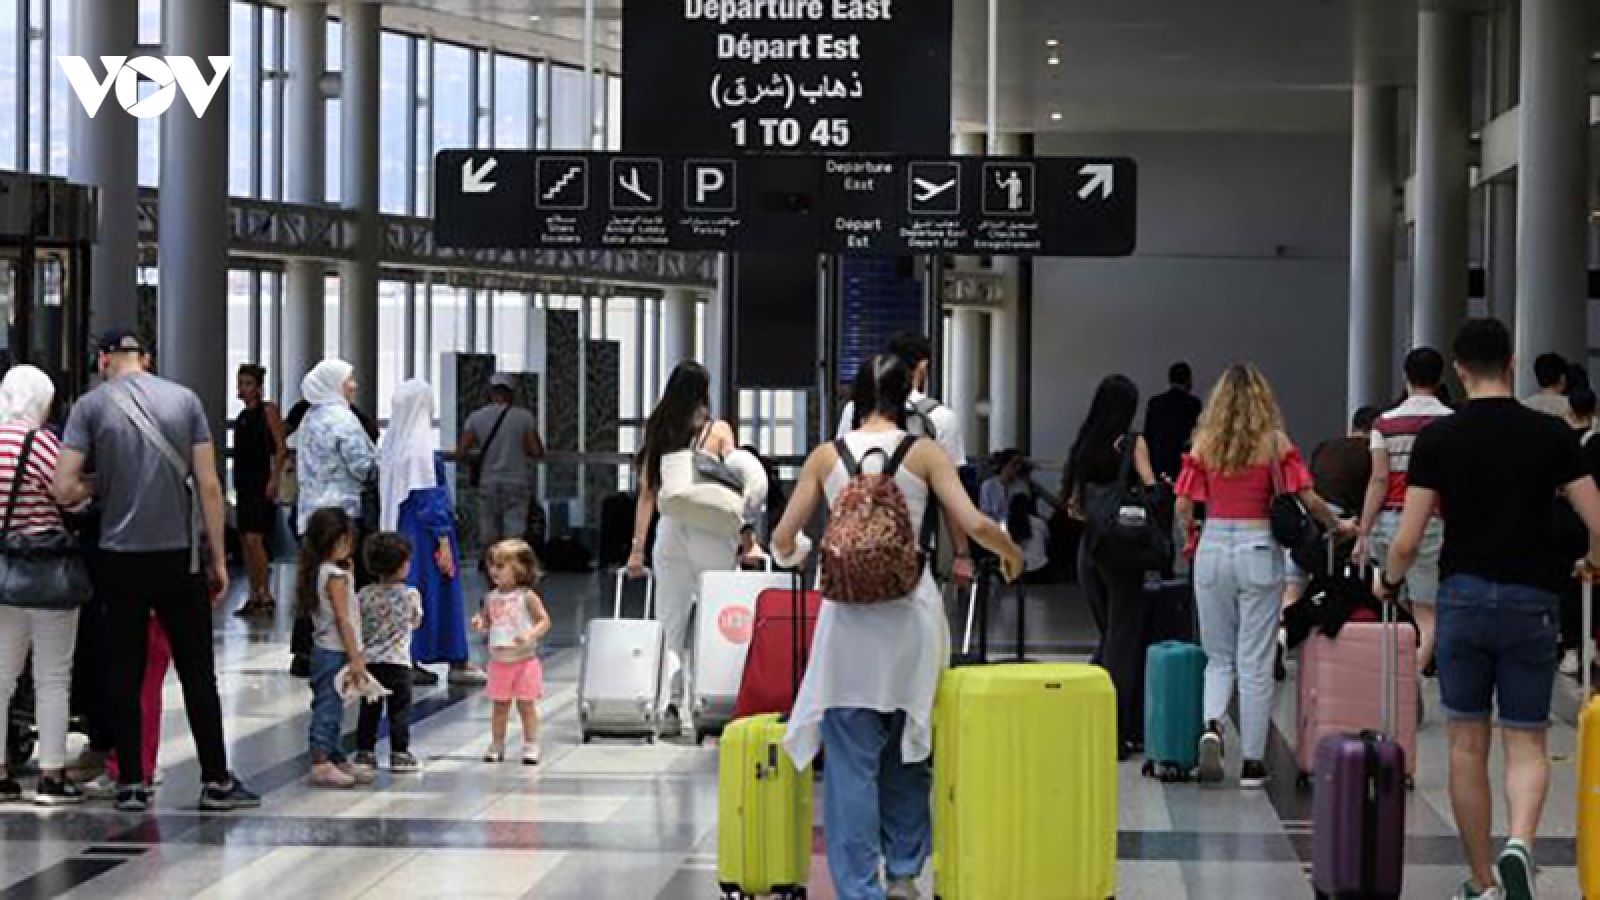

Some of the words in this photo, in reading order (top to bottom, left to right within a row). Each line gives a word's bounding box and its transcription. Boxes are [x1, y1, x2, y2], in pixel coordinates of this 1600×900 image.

[685, 0, 823, 24] Departure
[832, 0, 891, 19] East
[717, 32, 810, 63] Départ
[817, 34, 860, 59] Est
[800, 71, 862, 104] ذهاب
[730, 118, 746, 146] 1
[758, 118, 800, 146] TO
[809, 118, 850, 146] 45
